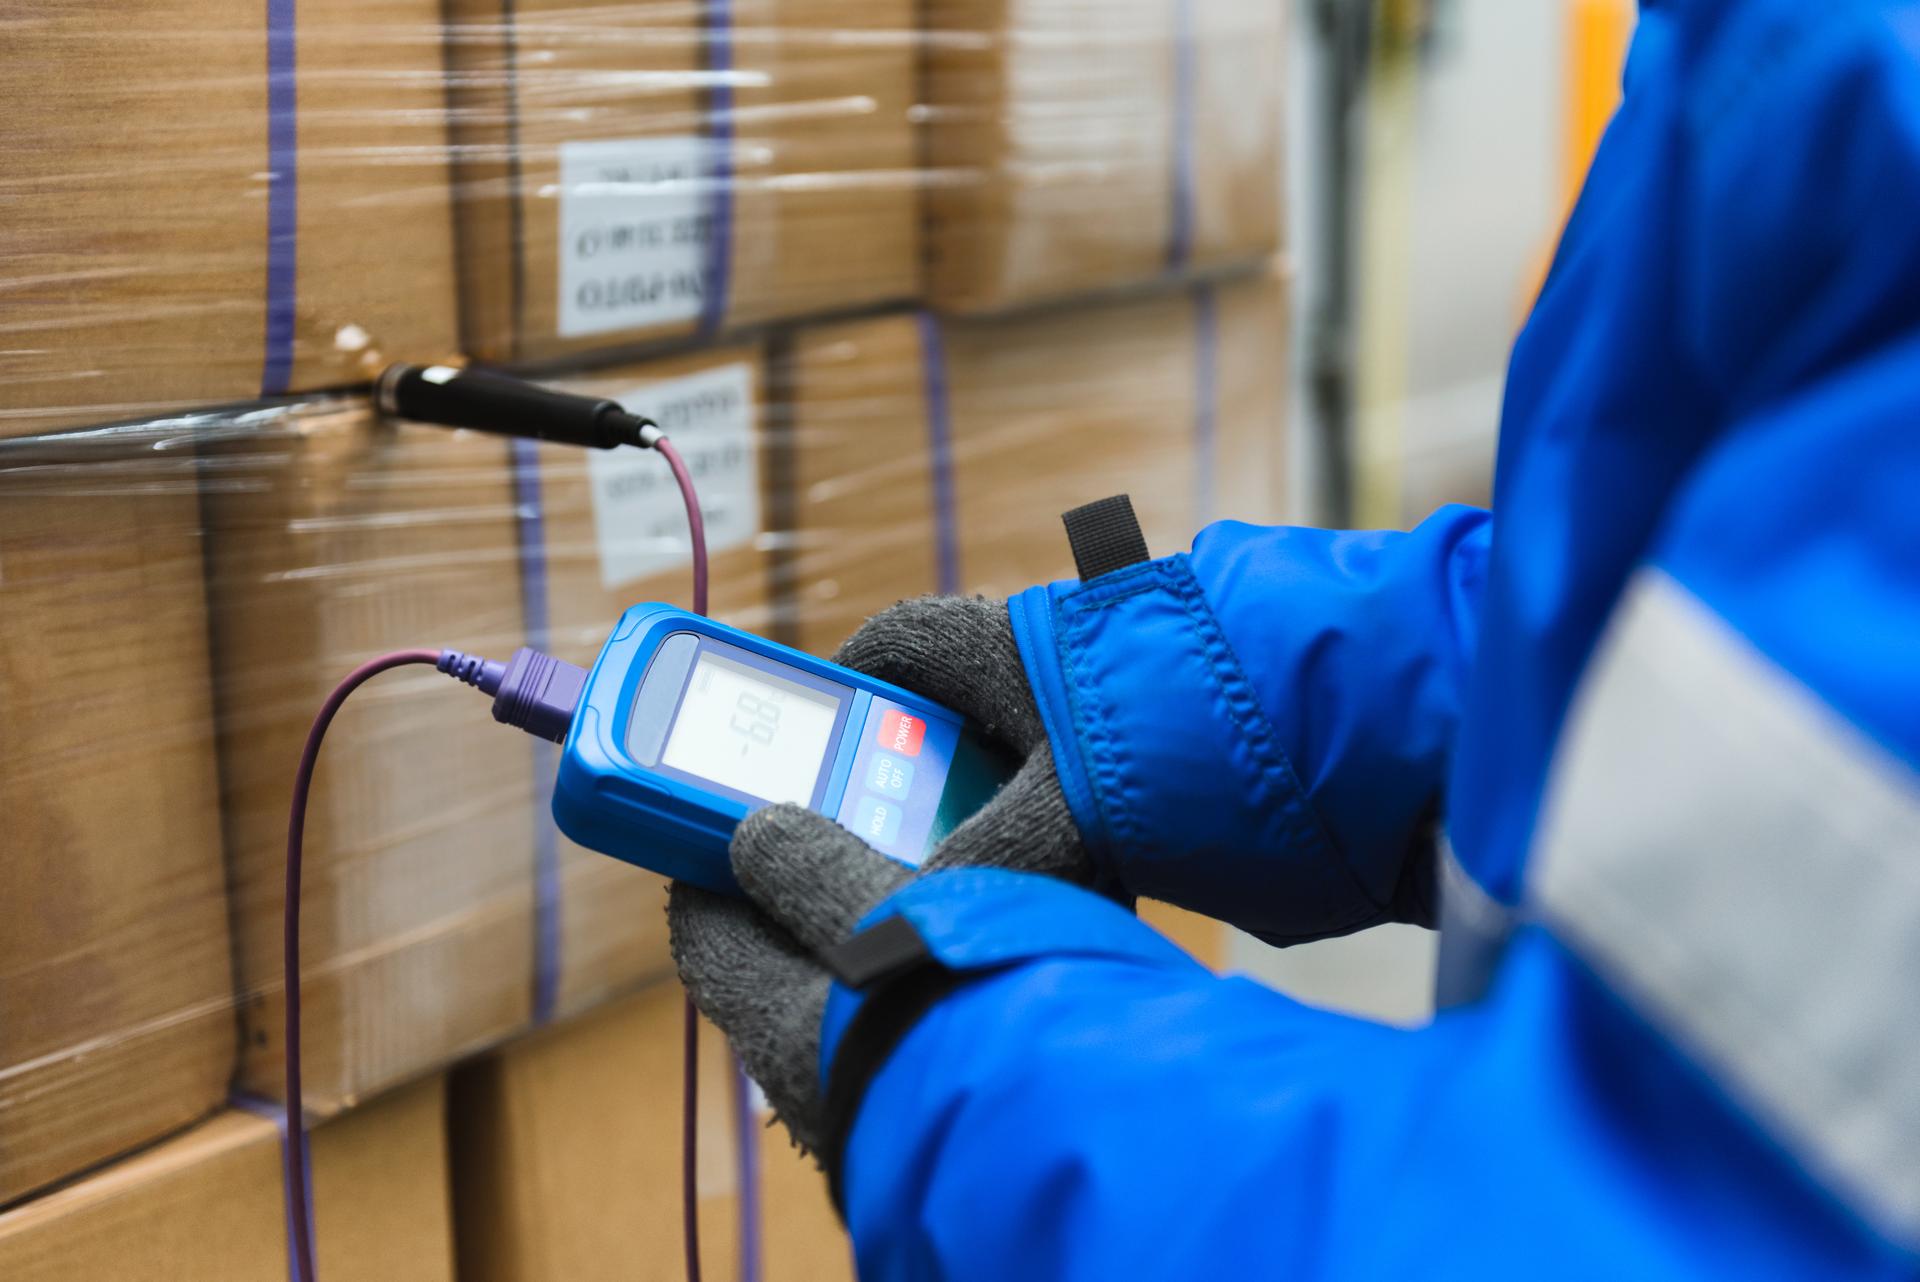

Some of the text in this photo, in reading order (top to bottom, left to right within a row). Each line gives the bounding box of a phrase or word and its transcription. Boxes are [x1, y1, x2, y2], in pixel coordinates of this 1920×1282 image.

[894, 716, 914, 752] POWER
[874, 758, 893, 789] AUTO
[890, 768, 905, 789] OFF
[869, 806, 888, 837] HOLD
